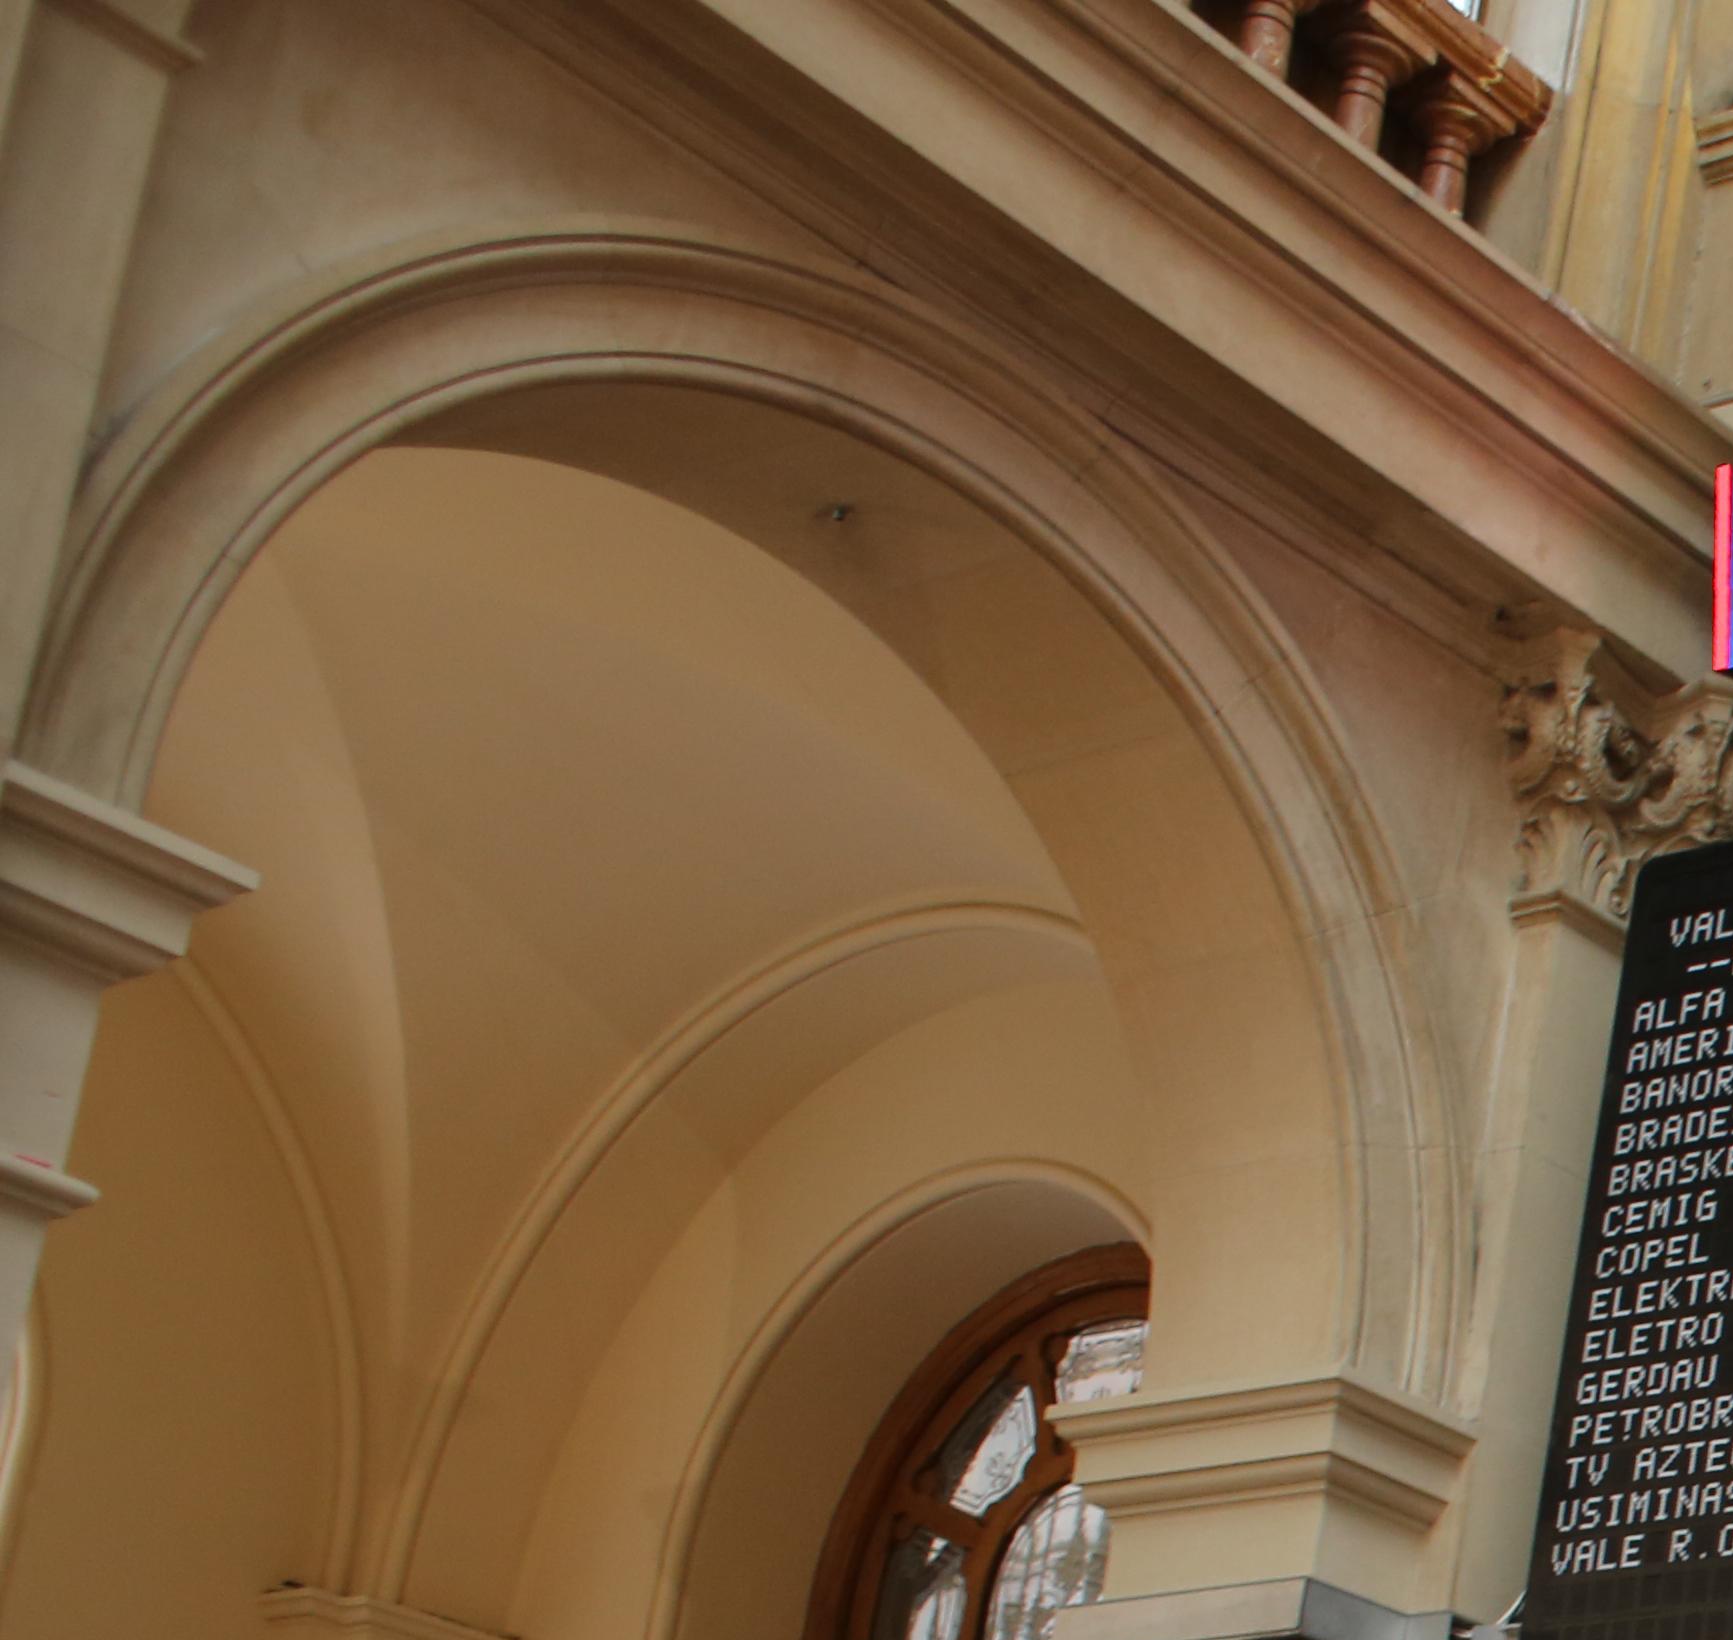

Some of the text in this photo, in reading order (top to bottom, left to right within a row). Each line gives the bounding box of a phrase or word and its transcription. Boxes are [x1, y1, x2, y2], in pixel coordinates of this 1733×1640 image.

[1601, 1188, 1718, 1238] CEMIG
[1581, 1310, 1725, 1364] ELETRO
[1575, 1354, 1719, 1406] GERDAU
